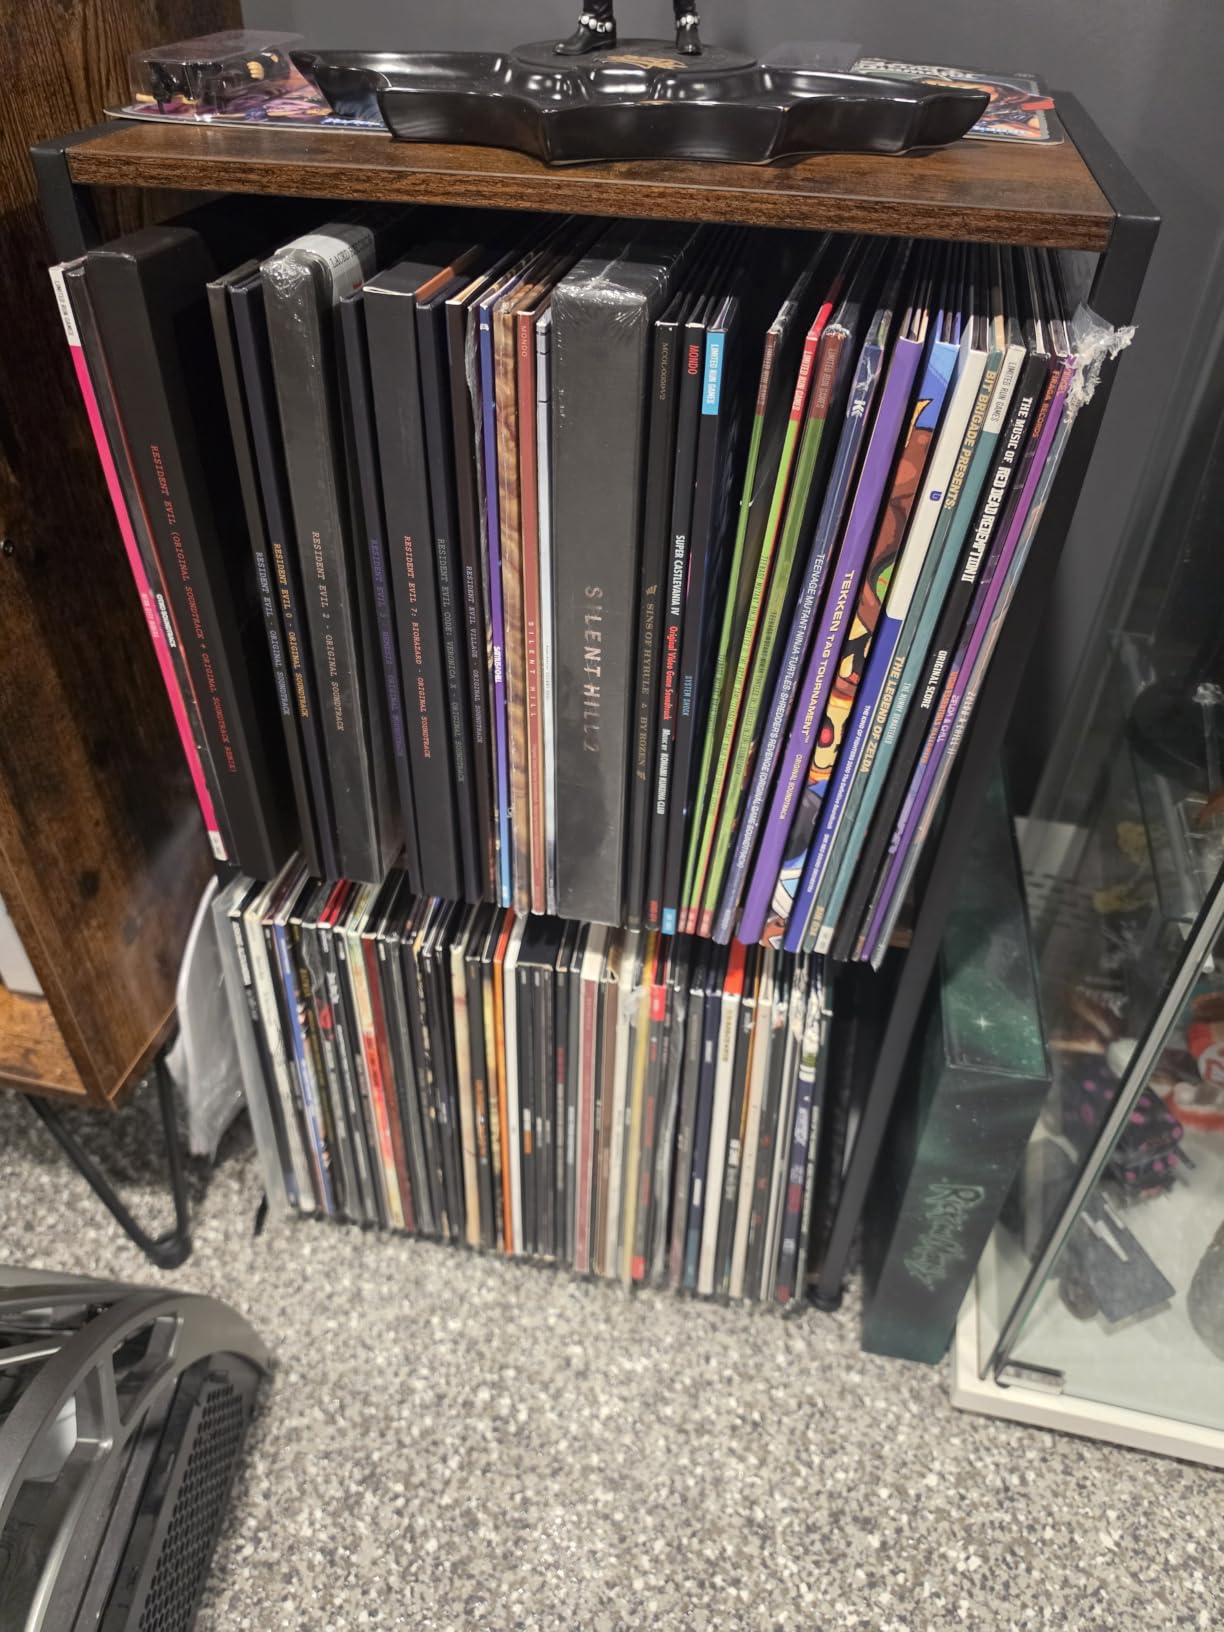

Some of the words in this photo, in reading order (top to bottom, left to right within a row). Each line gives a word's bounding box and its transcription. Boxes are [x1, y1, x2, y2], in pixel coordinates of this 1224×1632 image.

[519, 325, 528, 357] MONDO
[708, 343, 720, 368] LIMITED
[687, 344, 698, 374] MONDO
[799, 350, 812, 375] LIMITED
[823, 347, 836, 372] LIMITED
[1001, 360, 1017, 387] LIMITED
[707, 369, 717, 382] RUN
[796, 375, 807, 389] RUN
[980, 369, 996, 392] BIT
[1043, 369, 1060, 401] FIRAGA
[705, 383, 716, 404] GAMES
[791, 389, 804, 410] GAMES
[815, 387, 828, 409] GAMES
[996, 386, 1008, 401] RUN
[1016, 394, 1032, 418] THE
[963, 393, 988, 447] BRIGADE
[989, 400, 1004, 422] GAMES
[1031, 402, 1049, 438] RECORDS
[1006, 417, 1025, 450] MUSIC
[1001, 448, 1015, 463] OF
[943, 448, 971, 510] PRESENTS:
[993, 464, 1010, 489] RED
[984, 486, 1003, 516] DEAD
[149, 444, 169, 497] RESIDENT
[163, 500, 176, 525] EVIL
[170, 530, 190, 581] (ORIGINAL
[184, 585, 204, 640] SOUNDTRACK
[311, 530, 325, 580] RESIDENT
[402, 535, 414, 578] RESIDENT
[674, 535, 685, 558] SUPER
[964, 513, 994, 576] REDEMPTION
[436, 537, 447, 582] RESIDENT
[806, 553, 824, 595] TEENAGE
[318, 584, 328, 607] EVIL
[407, 581, 416, 603] EVIL
[440, 586, 449, 607] EVIL
[465, 565, 474, 603] RESIDENT
[670, 559, 683, 605] CASTLEVANIA
[409, 607, 417, 617] 7:
[467, 606, 475, 624] EVIL
[645, 602, 654, 629] SINS
[670, 607, 679, 615] IV
[797, 594, 813, 630] MUTANT
[828, 568, 854, 633] TEKKEN
[254, 550, 269, 594] RESIDENT
[262, 596, 273, 617] EVIL
[268, 629, 282, 668] ORIGINAL
[275, 670, 291, 716] SOUNDTRACK
[272, 542, 287, 586] RESIDENT
[280, 588, 291, 608] EVIL
[287, 631, 301, 669] ORIGINAL
[294, 672, 309, 718] SOUNDTRACK
[411, 621, 422, 664] BIOHAZARD
[469, 628, 477, 658] VILLAGE
[583, 585, 602, 677] SILENT
[644, 631, 653, 646] OF
[667, 625, 678, 650] Original
[791, 630, 804, 655] NINJA
[822, 632, 836, 658] TAG
[324, 633, 337, 676] ORIGINAL
[445, 641, 455, 679] VERONICA
[527, 621, 535, 674] SILENT
[666, 651, 676, 669] Video
[641, 649, 652, 694] HYRULE
[665, 670, 675, 687] Game
[889, 654, 905, 679] THE
[928, 648, 947, 686] ORIGINAL
[416, 676, 427, 712] ORIGINAL
[472, 669, 480, 701] ORIGINAL
[920, 685, 935, 709] SCORE
[330, 680, 344, 731] SOUNDTRACK
[582, 683, 600, 735] HILL
[662, 688, 673, 720] Soundtrack
[769, 691, 788, 739] SHREDDER'S
[861, 703, 870, 716] THE
[875, 679, 897, 724] LEGEND
[945, 693, 959, 717] ZELDA
[420, 715, 431, 758] SOUNDTRACK
[474, 705, 483, 743] SOUNDTRACK
[639, 716, 648, 731] BY
[857, 715, 866, 729] KING
[870, 723, 882, 740] OF
[936, 723, 949, 744] CHILL
[637, 732, 647, 766] ROZEN
[760, 738, 776, 772] REVENGE
[859, 740, 876, 773] ZELDA
[788, 752, 802, 781] ORIGINAL
[656, 801, 664, 814] CLUB
[778, 781, 794, 820] SOUNDTRACK
